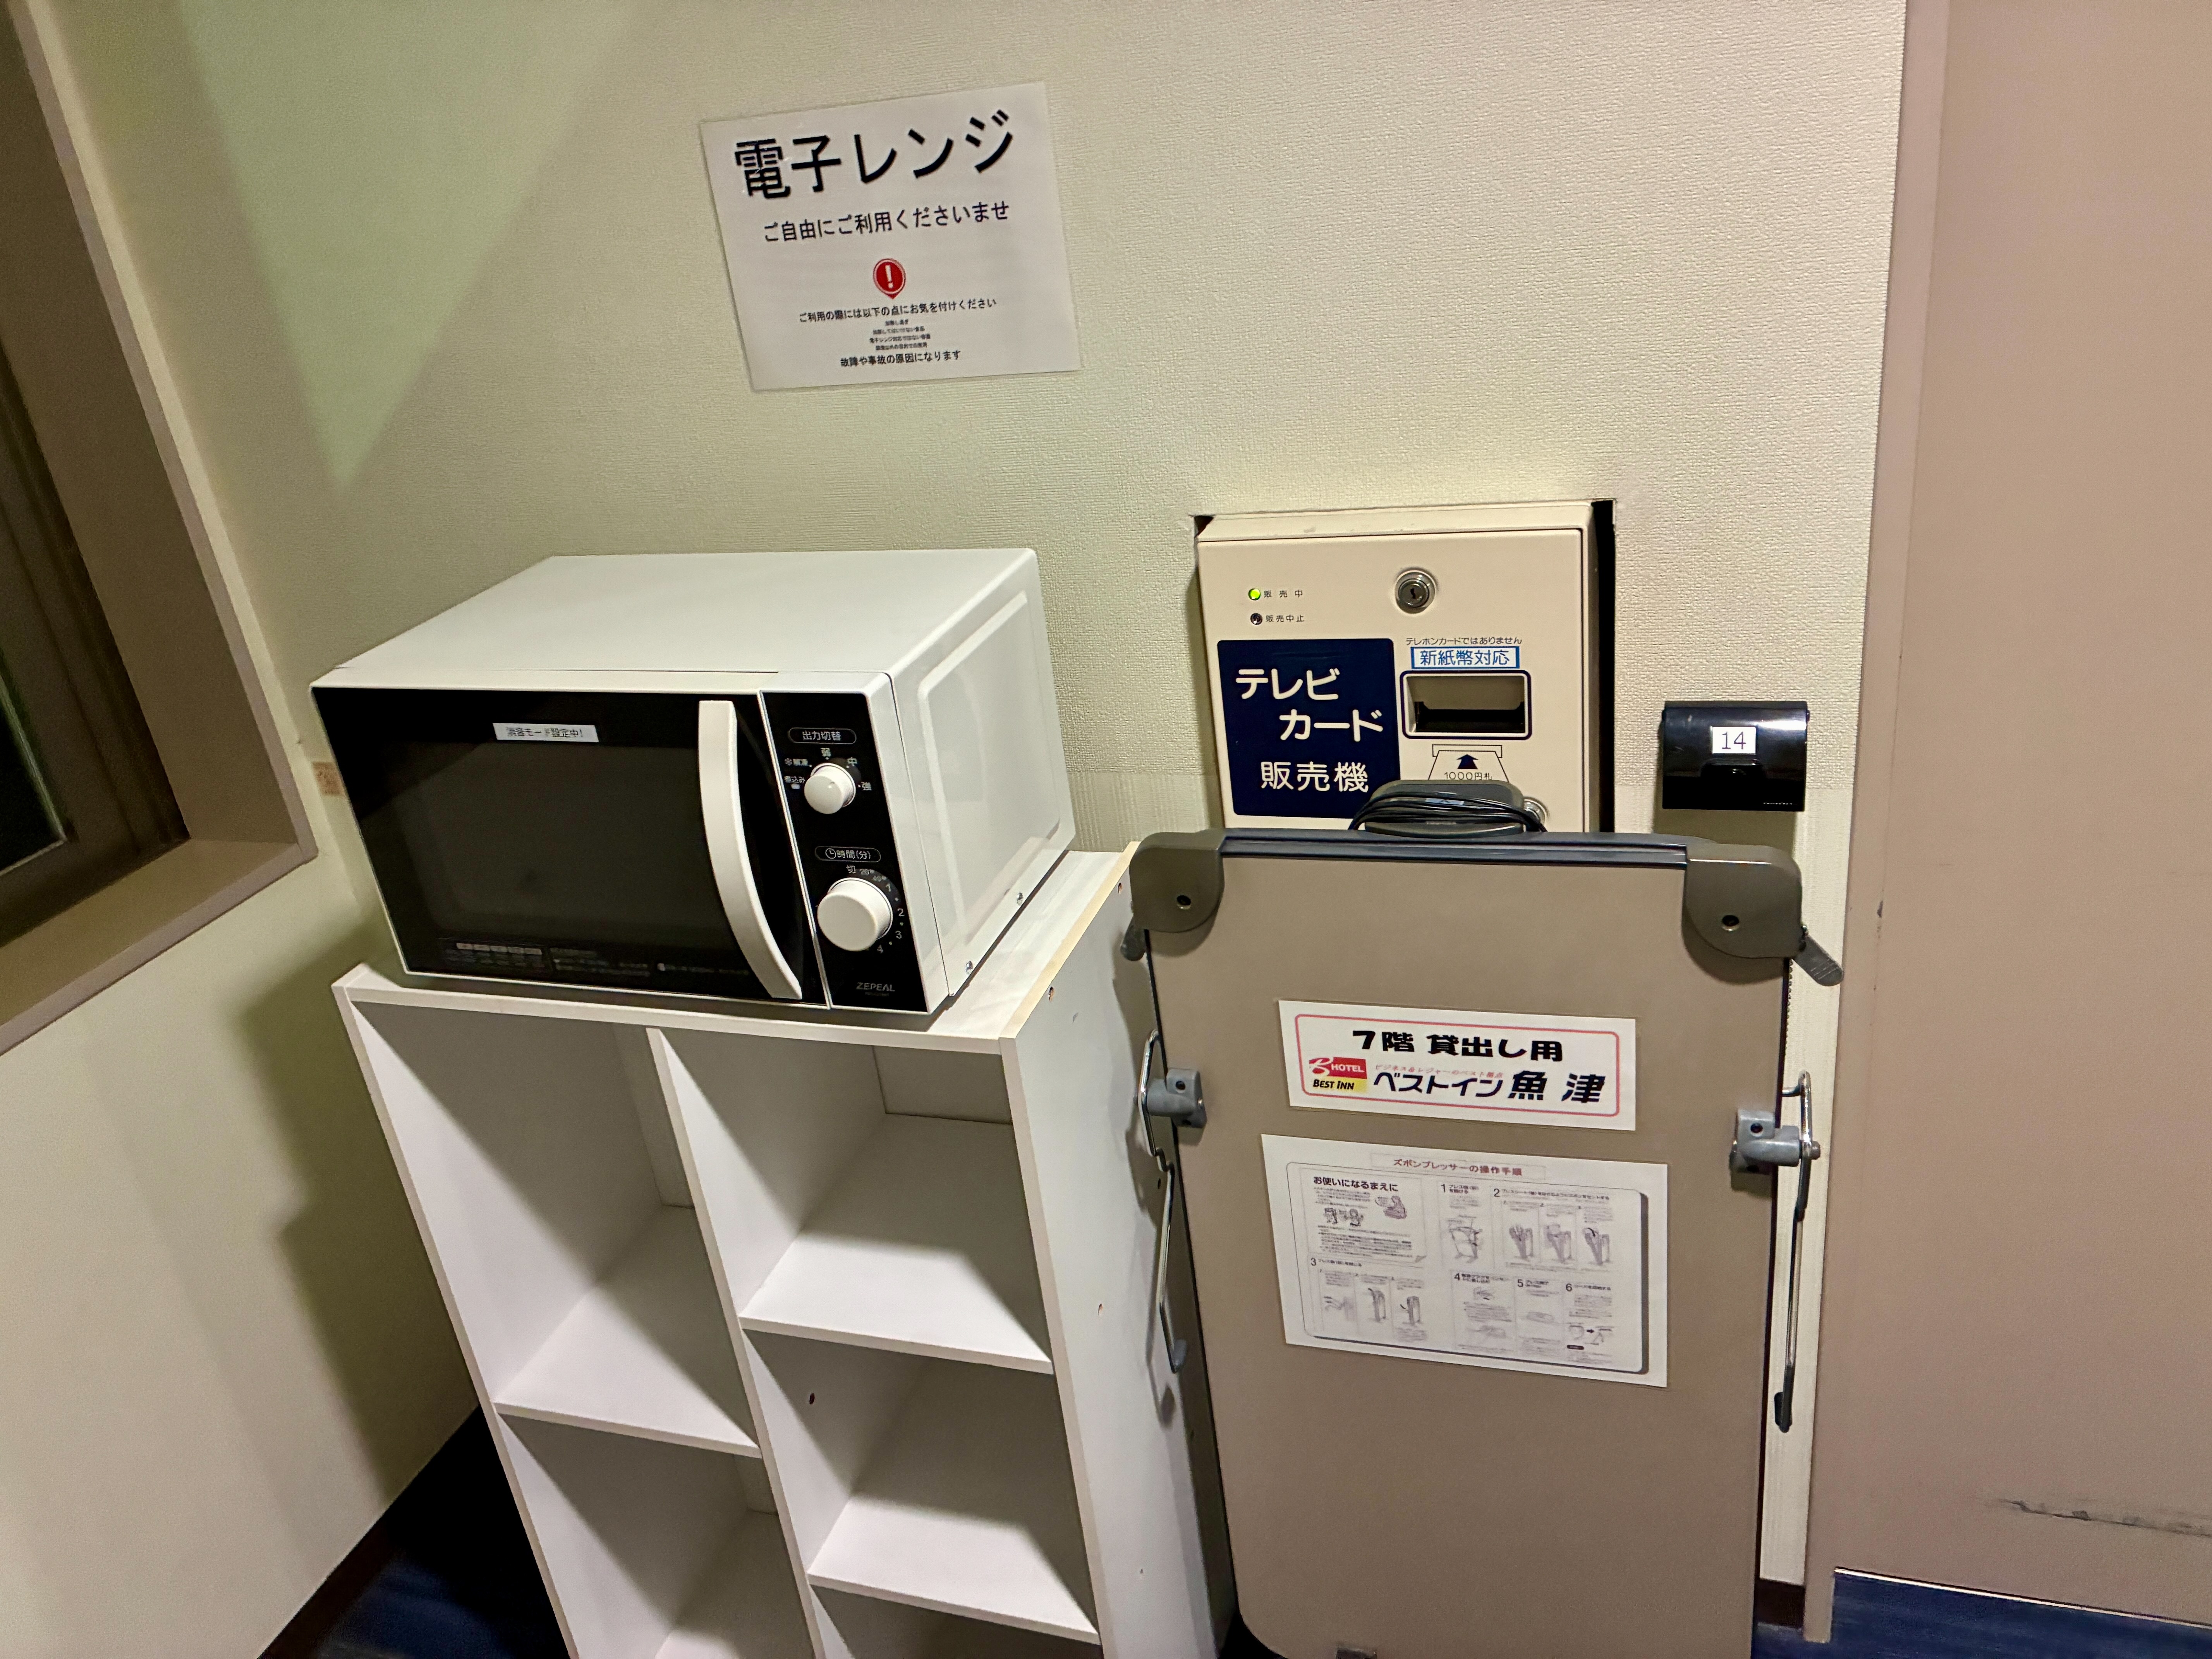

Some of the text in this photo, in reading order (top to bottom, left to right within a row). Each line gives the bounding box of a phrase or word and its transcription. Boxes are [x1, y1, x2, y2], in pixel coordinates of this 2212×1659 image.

[735, 108, 1014, 200] 電子レンジ
[764, 201, 1010, 242] ご自由にご利用くださいませ
[799, 297, 998, 323] ご利用の際には以下の点にお気を付けください
[840, 349, 962, 368] 故障や事故の原因になります
[1264, 589, 1303, 598] 販売中
[1266, 614, 1305, 623] 販売中止
[1405, 637, 1522, 646] テレホンカードではありません
[1420, 649, 1510, 666] 新紙幣対応
[1235, 666, 1341, 701] テレビ
[1278, 708, 1385, 742] カード
[802, 730, 842, 741] 出力切替
[1721, 731, 1747, 750] 14
[847, 757, 858, 766] 中
[1260, 760, 1370, 794] 販売機
[1444, 771, 1493, 780] 1000円札
[897, 908, 905, 917] 2
[895, 930, 902, 939] 3
[876, 944, 884, 953] 4
[856, 982, 896, 992] ZEPEAL
[1426, 1033, 1564, 1063] 貸出し用
[1331, 1063, 1365, 1073] HOTEL
[1313, 1079, 1335, 1089] BEST
[1313, 1176, 1399, 1192] お使いになるまえに
[1441, 1183, 1446, 1193] 1
[1493, 1188, 1500, 1197] 2
[1310, 1257, 1317, 1266] 3
[1454, 1273, 1460, 1281] 4
[1517, 1279, 1524, 1288] 5
[1566, 1283, 1573, 1292] 6
